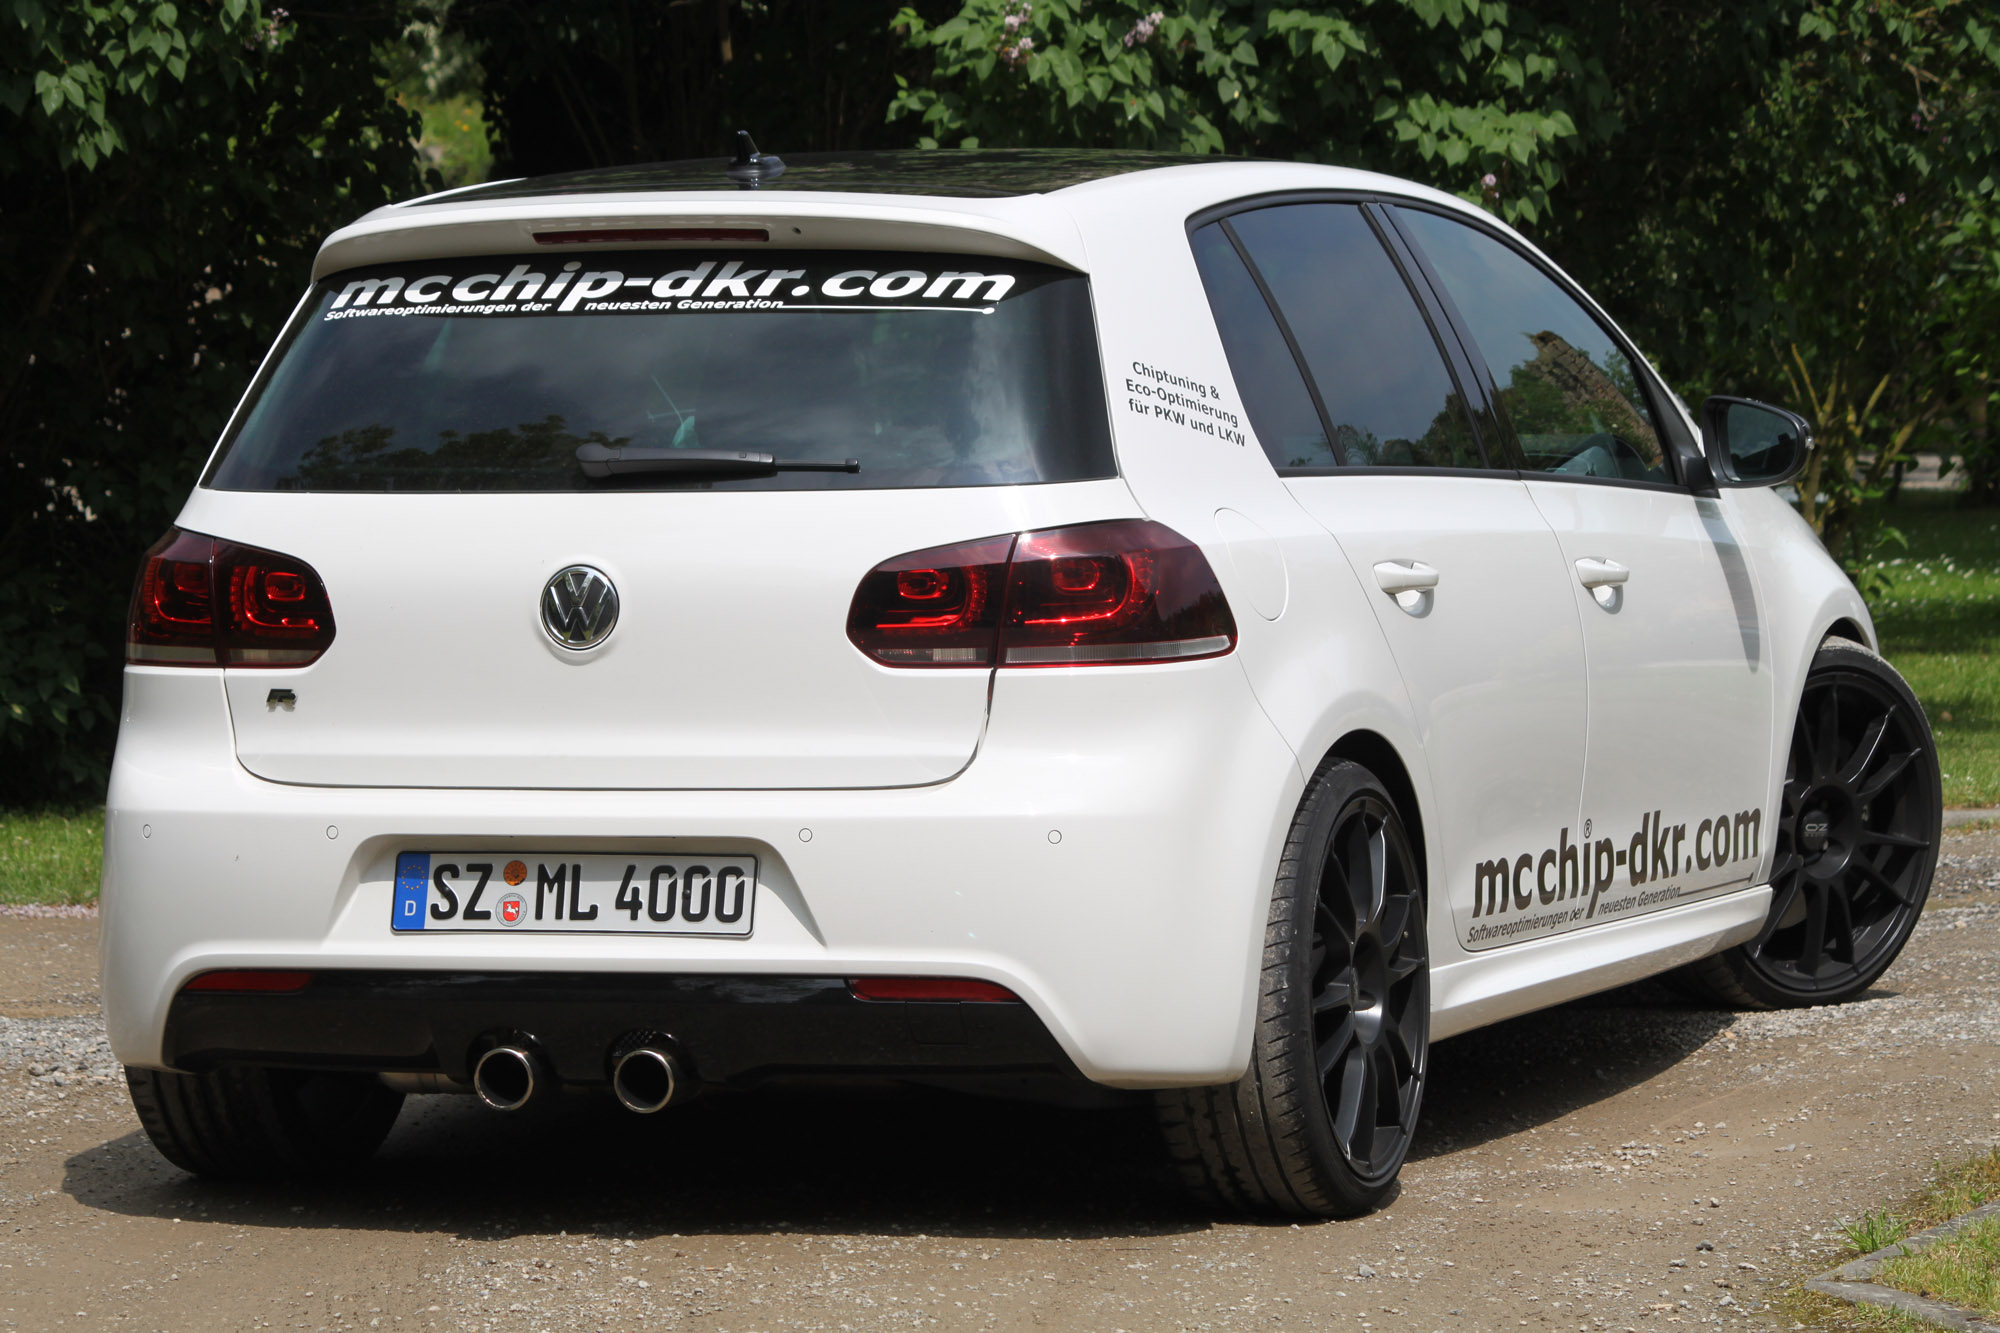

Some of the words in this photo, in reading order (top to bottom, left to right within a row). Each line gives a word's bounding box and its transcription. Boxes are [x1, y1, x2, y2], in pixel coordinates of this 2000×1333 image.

[324, 301, 519, 321] Softwareoptimierungen
[521, 301, 551, 311] der
[585, 300, 671, 310] neuesten
[677, 298, 784, 310] Generation
[331, 261, 1016, 312] mcchip-dkr.com
[1125, 378, 1238, 428] Eco-Optimierung
[1132, 361, 1206, 398] Chiptuning
[1210, 385, 1221, 400] &
[1128, 398, 1150, 415] für
[1154, 405, 1185, 425] PKW
[1190, 418, 1214, 435] und
[1218, 425, 1245, 447] LKW
[1472, 807, 1761, 920] mcchip-dkr.com
[404, 900, 416, 916] D
[430, 863, 493, 920] SZ
[535, 863, 598, 921] ML
[615, 864, 745, 923] 4000
[1467, 910, 1568, 943] Softwareoptimierungen
[1598, 895, 1637, 916] neuesten
[1637, 884, 1681, 907] Generation
